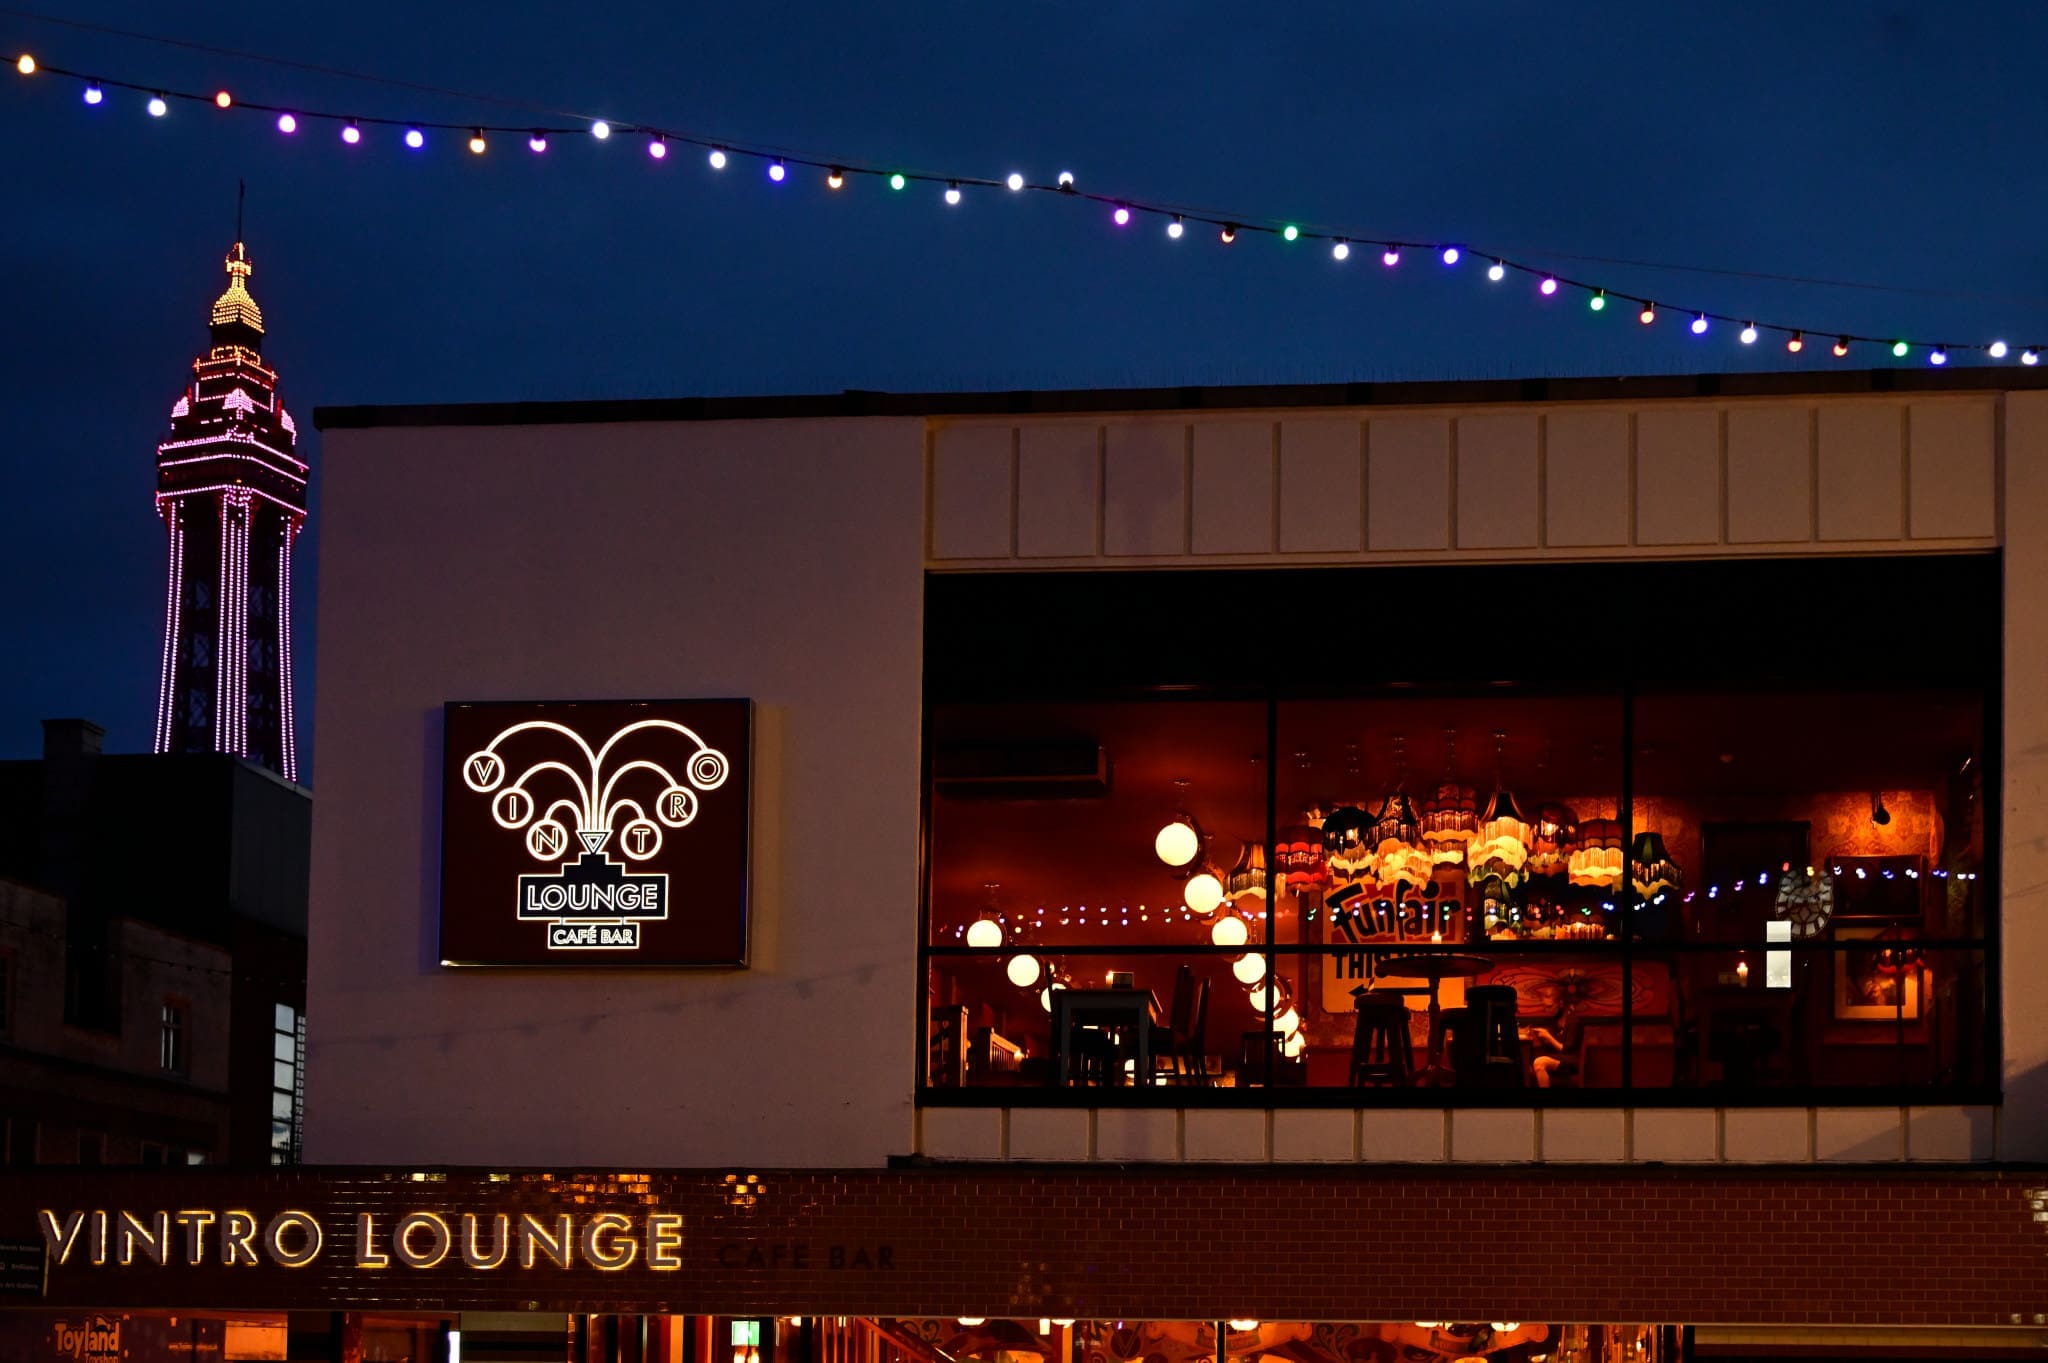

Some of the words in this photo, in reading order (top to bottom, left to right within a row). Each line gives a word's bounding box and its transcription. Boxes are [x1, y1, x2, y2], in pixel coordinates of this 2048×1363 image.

[527, 883, 658, 911] LOUNGE
[1326, 879, 1461, 943] Funfair
[553, 926, 597, 945] CAFÉ
[600, 930, 634, 945] BAR
[38, 1208, 323, 1269] VINTRO
[356, 1211, 683, 1272] LOUNGE
[829, 1245, 896, 1270] BAR
[53, 1320, 121, 1360] Toyland
